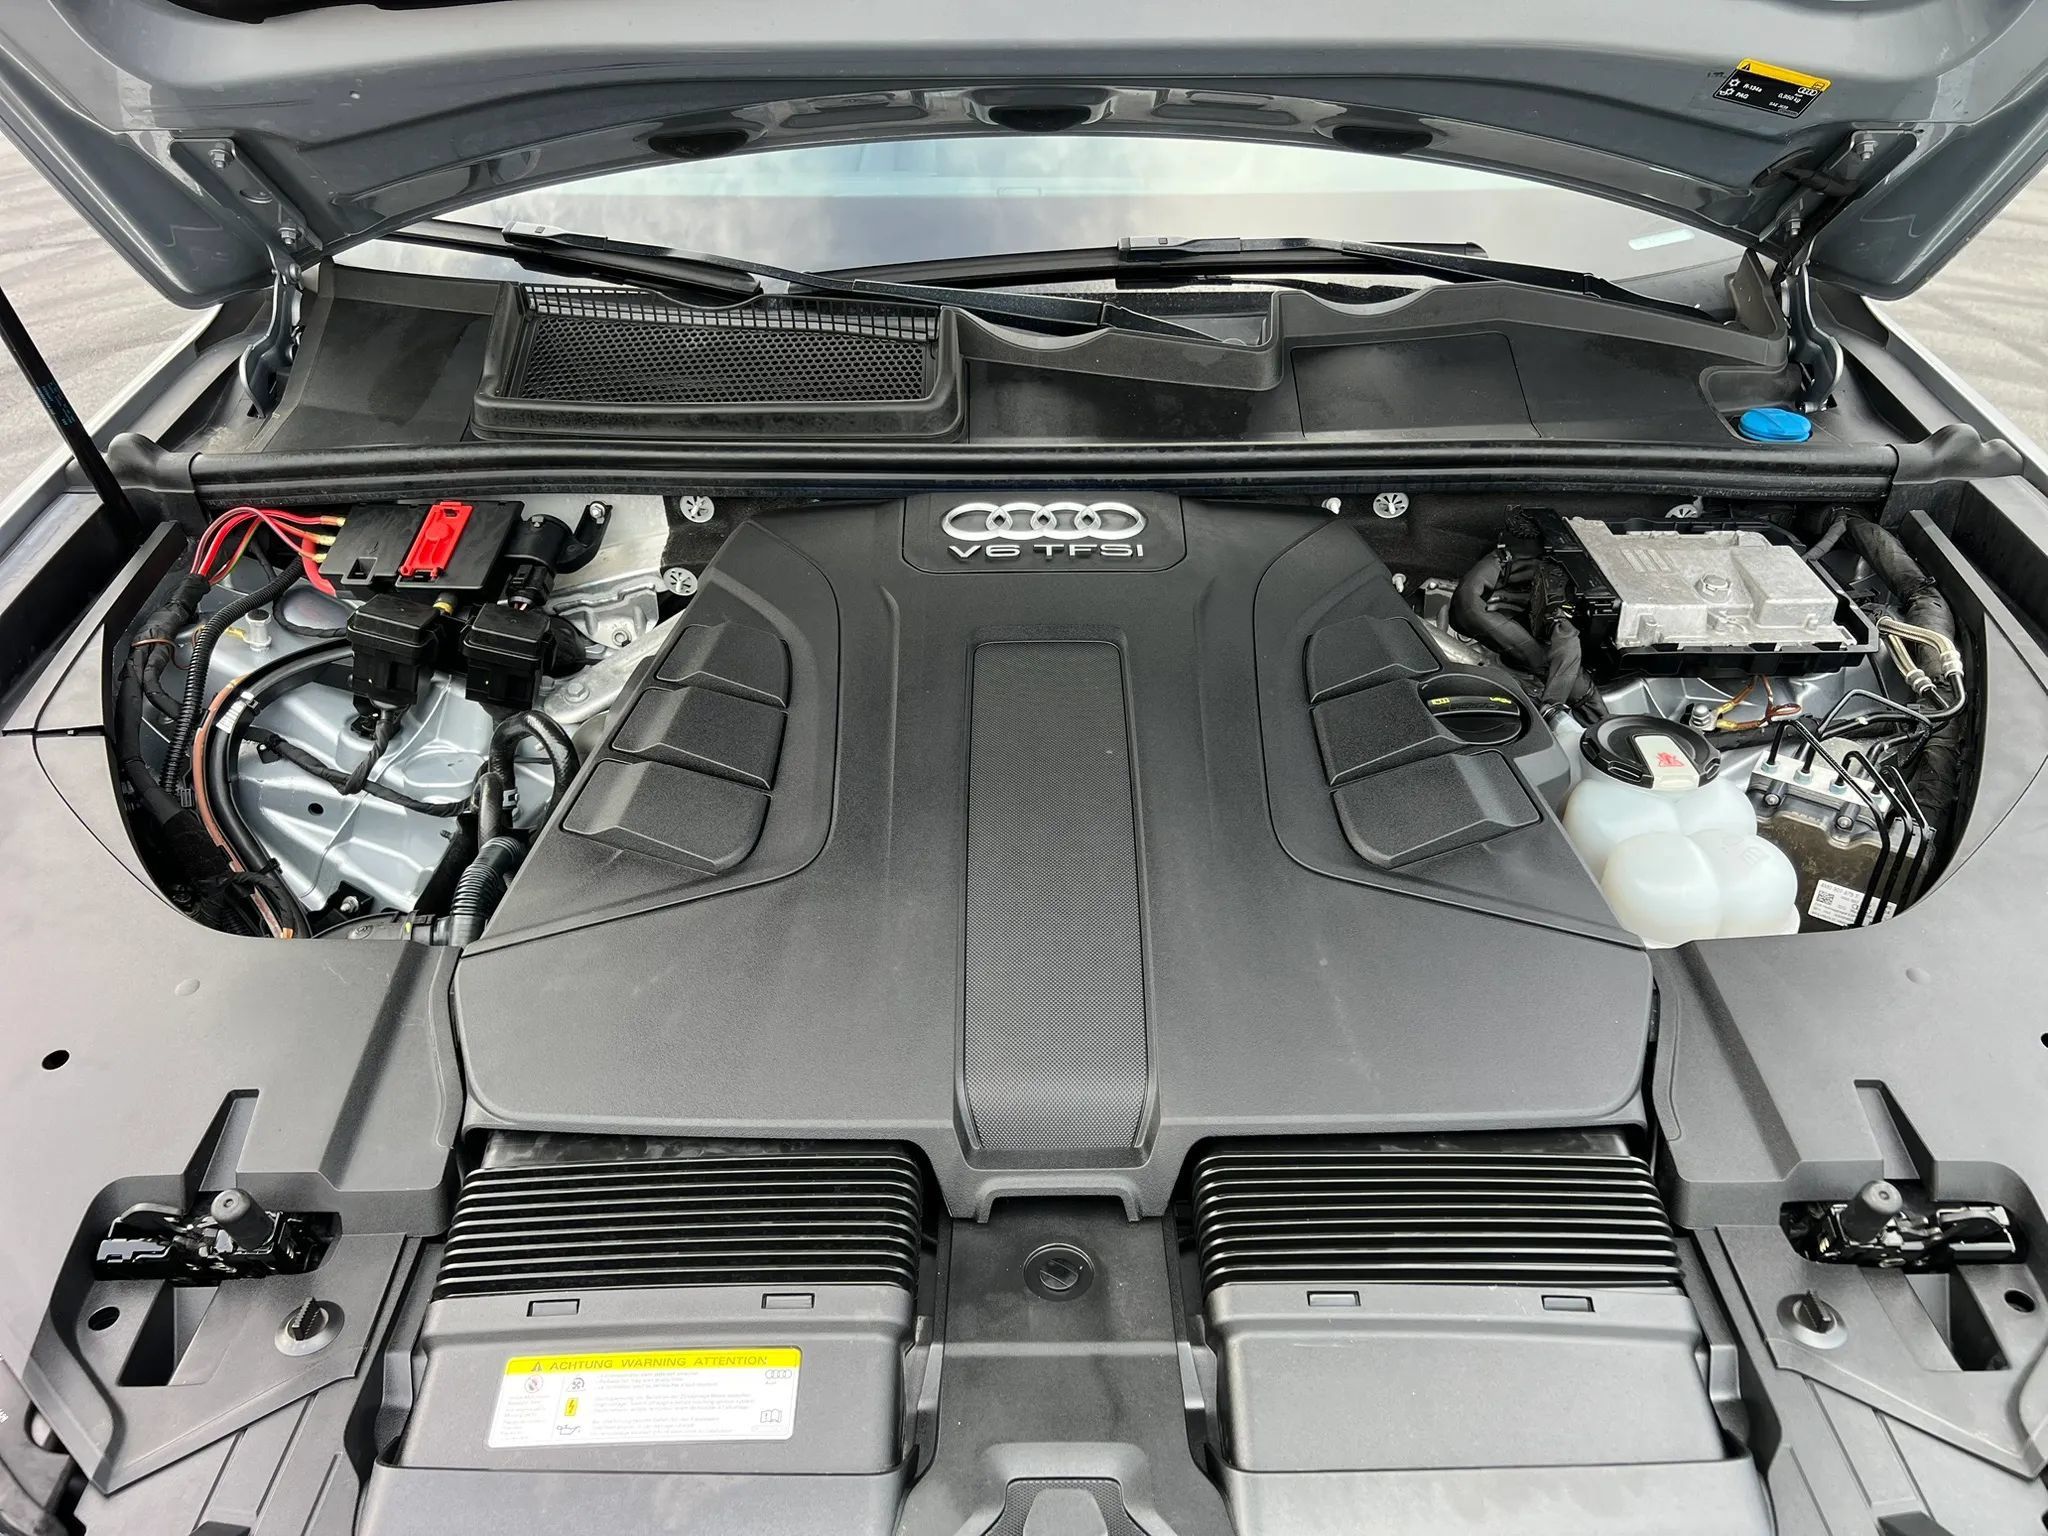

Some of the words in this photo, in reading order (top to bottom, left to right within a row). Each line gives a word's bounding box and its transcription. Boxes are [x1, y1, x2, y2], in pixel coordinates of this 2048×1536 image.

[949, 544, 1021, 559] V6
[1033, 543, 1144, 559] TFSI
[550, 1360, 613, 1370] ACHTUNG
[621, 1358, 687, 1368] WARNING
[693, 1356, 768, 1366] ATTENTION
